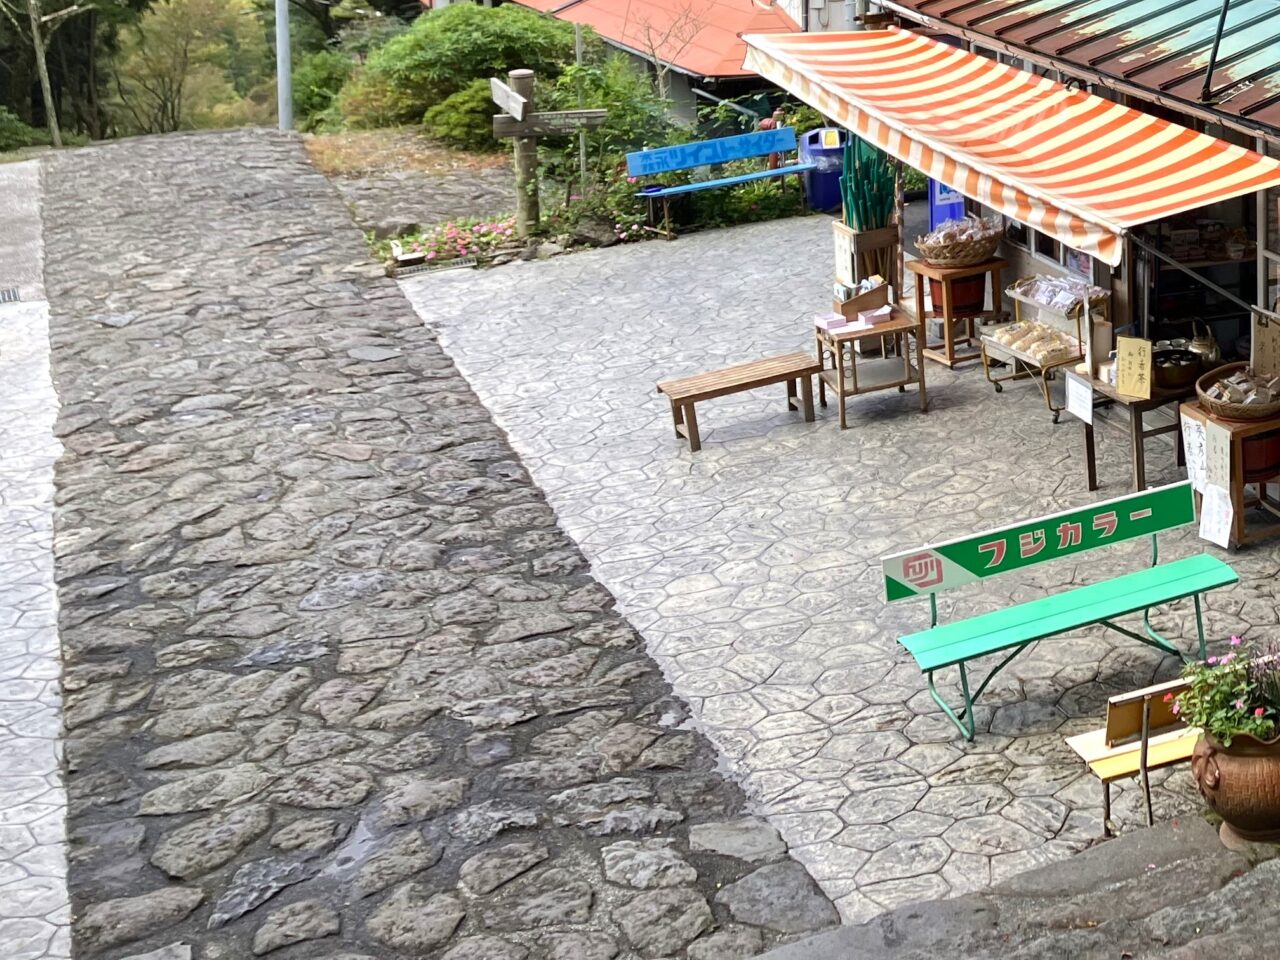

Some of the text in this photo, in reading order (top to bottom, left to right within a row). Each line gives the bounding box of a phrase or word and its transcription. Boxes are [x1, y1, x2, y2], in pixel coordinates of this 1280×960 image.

[978, 508, 1152, 568] フジカラー
